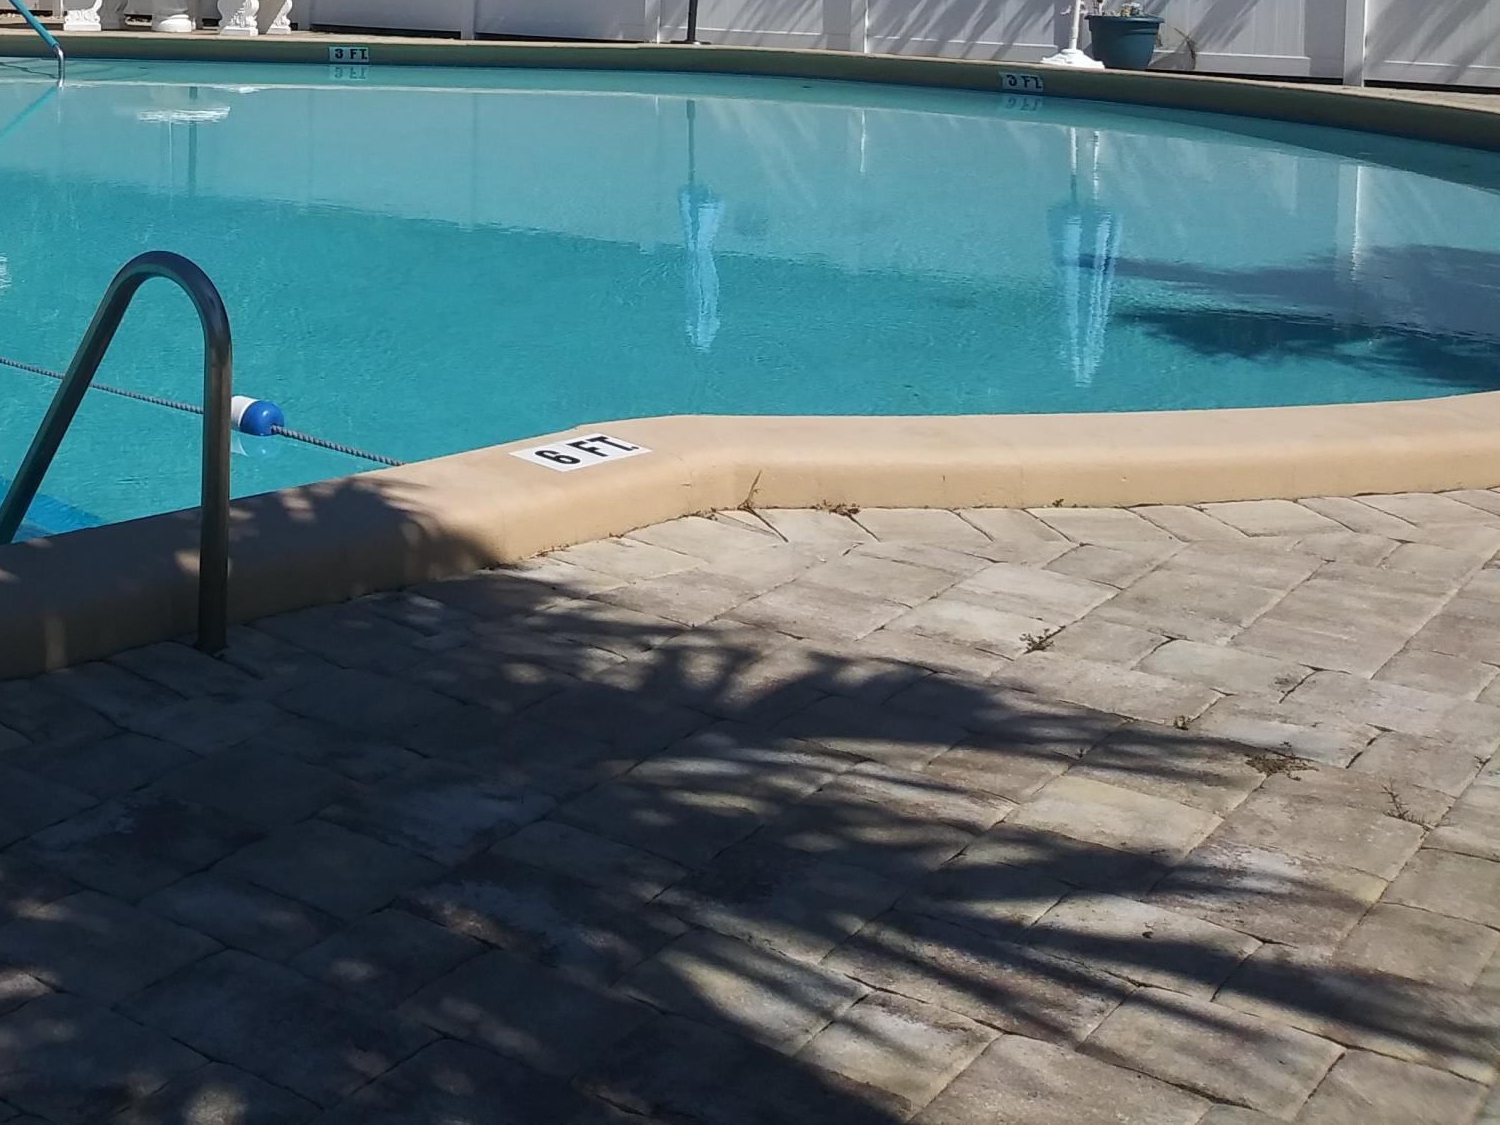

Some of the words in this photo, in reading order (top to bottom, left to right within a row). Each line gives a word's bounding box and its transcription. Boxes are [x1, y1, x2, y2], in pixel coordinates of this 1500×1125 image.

[334, 48, 344, 60] 3
[534, 449, 582, 465] 6
[565, 435, 640, 458] FT.
